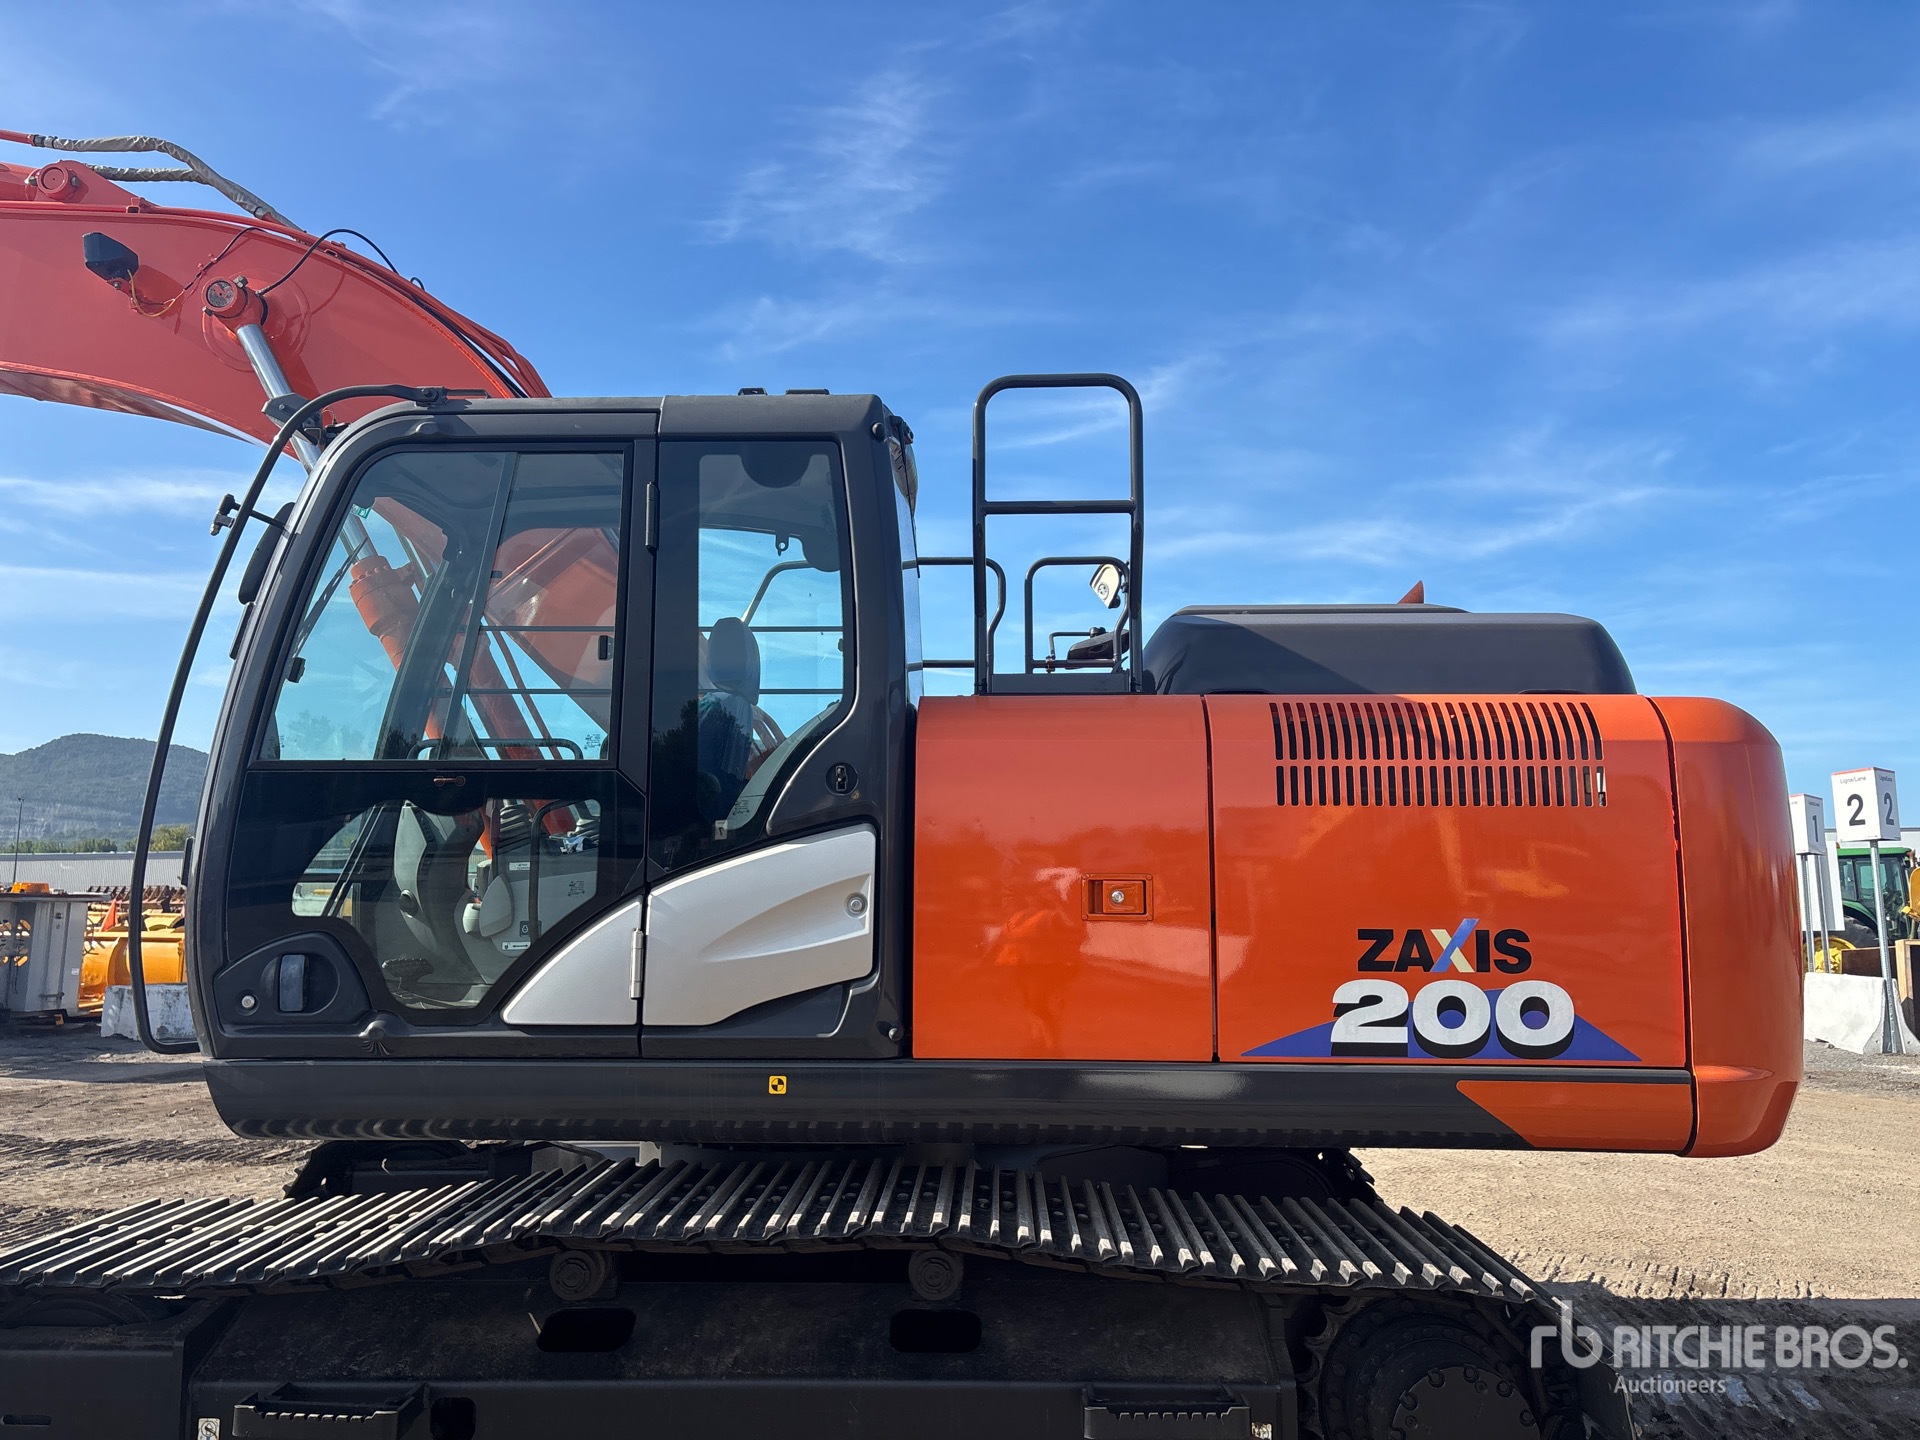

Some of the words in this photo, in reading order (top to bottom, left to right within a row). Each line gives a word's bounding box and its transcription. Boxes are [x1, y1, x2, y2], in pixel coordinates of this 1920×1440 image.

[1847, 793, 1865, 826] 2
[1884, 792, 1894, 825] 2
[1812, 815, 1818, 842] 1
[1357, 918, 1532, 974] ZAXIS
[1330, 979, 1575, 1058] 200
